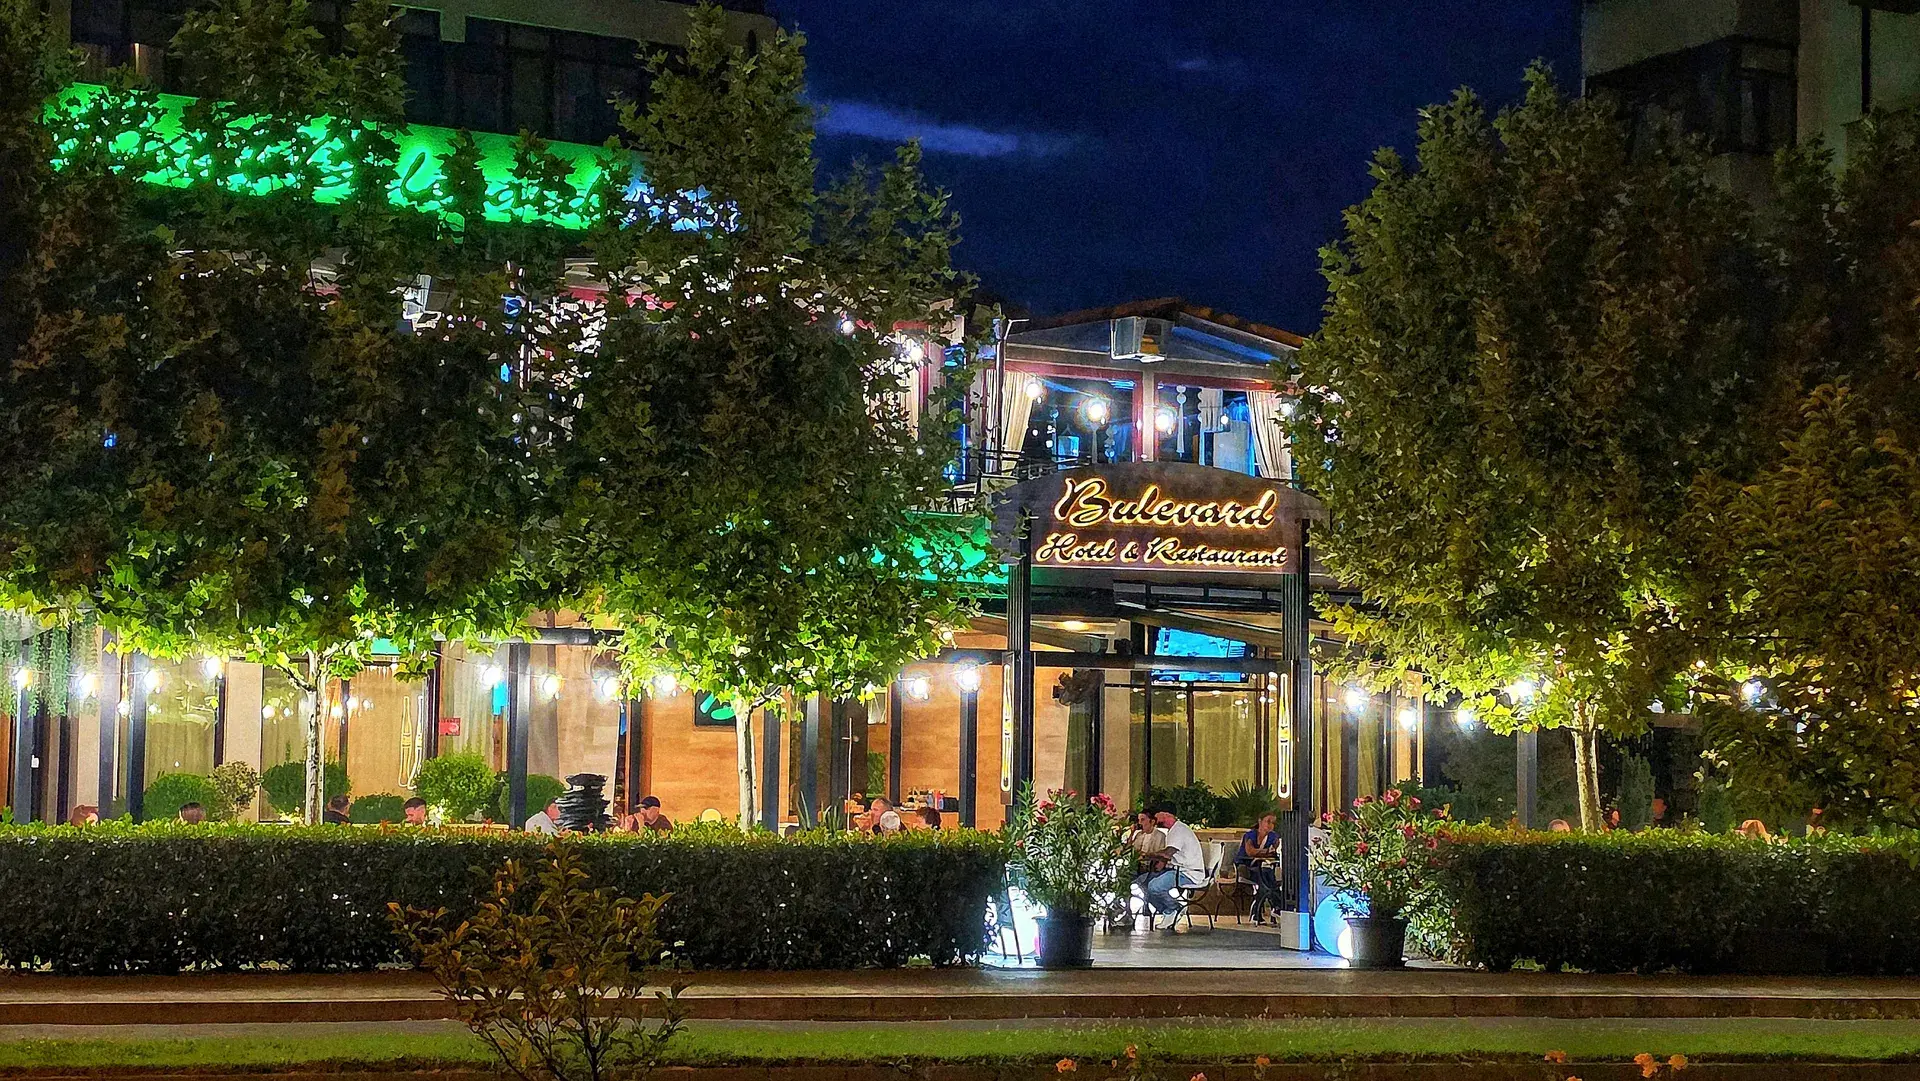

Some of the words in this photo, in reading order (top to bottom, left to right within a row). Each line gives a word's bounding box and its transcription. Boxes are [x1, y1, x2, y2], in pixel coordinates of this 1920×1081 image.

[1054, 478, 1277, 529] Bulevard
[1036, 532, 1117, 563] Hotel
[1120, 541, 1139, 563] &
[1144, 537, 1288, 567] Restaurant
